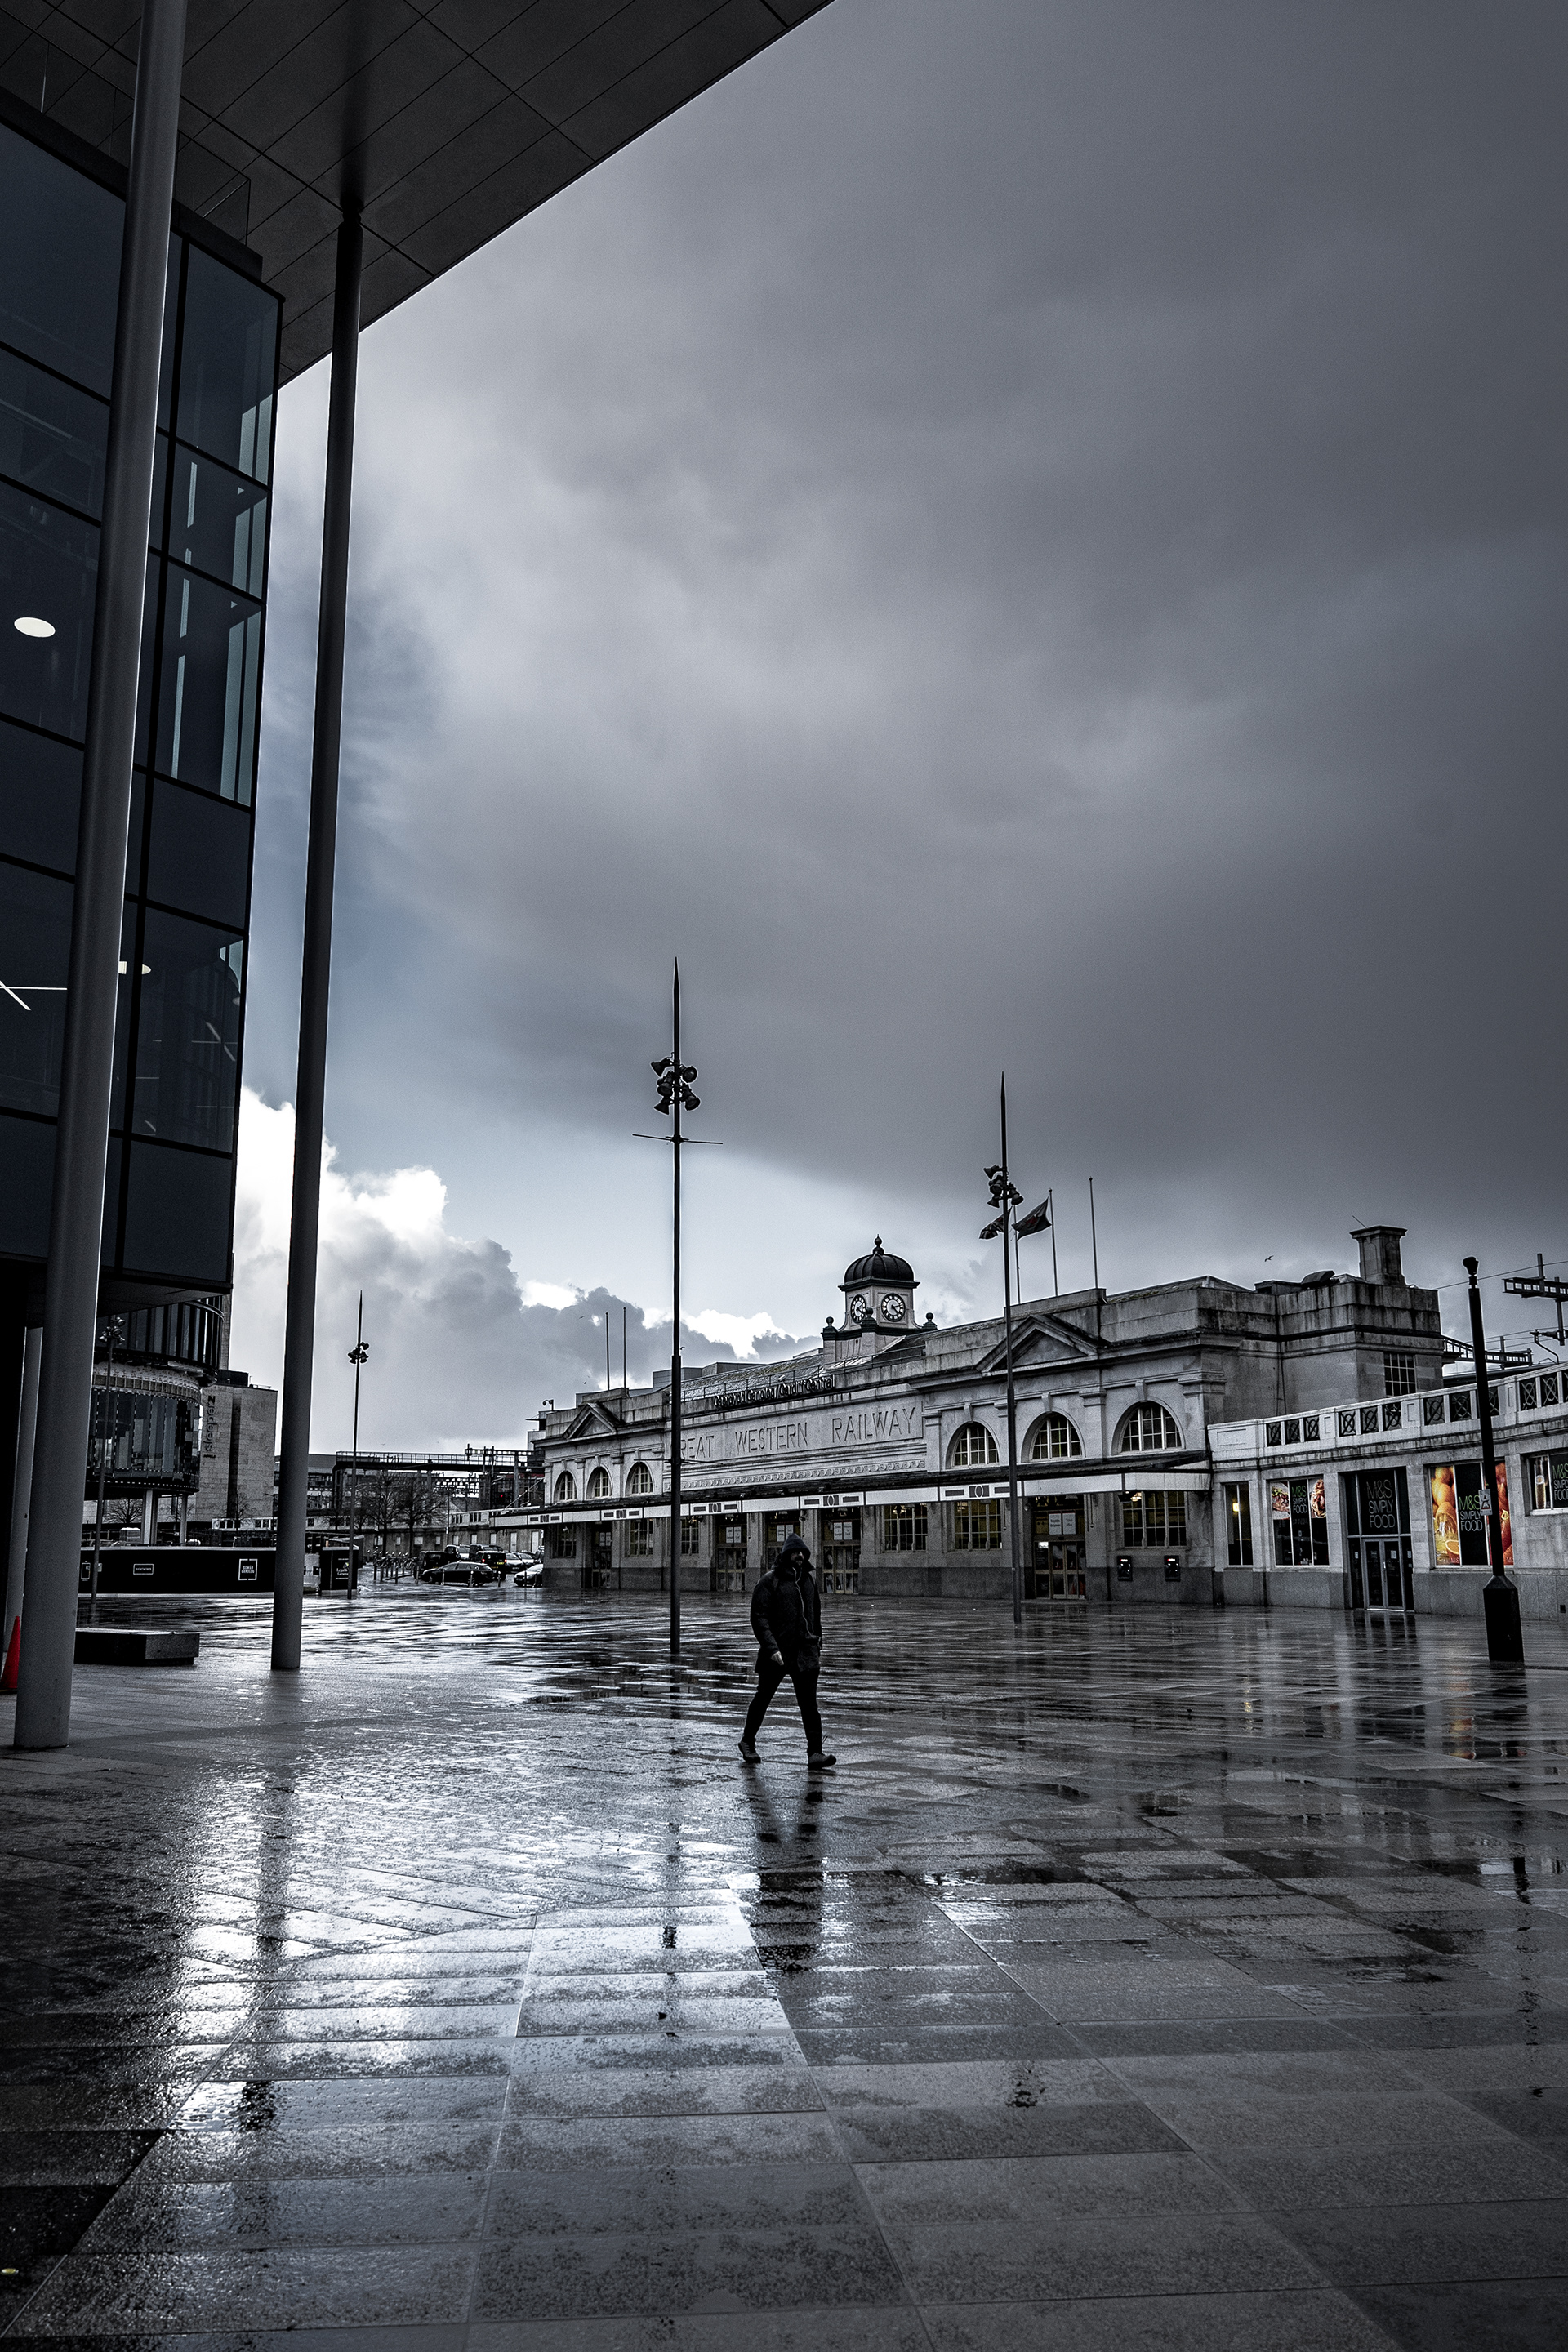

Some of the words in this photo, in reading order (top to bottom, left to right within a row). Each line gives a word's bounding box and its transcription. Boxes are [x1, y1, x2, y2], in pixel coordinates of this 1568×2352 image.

[805, 1374, 836, 1392] Central
[673, 1435, 715, 1460] REAT
[735, 1422, 808, 1454] WESTERN
[831, 1406, 916, 1443] RAILWAY
[1291, 1485, 1307, 1498] M&S
[1365, 1479, 1392, 1499] M&S
[1554, 1488, 1568, 1501] FOO
[1293, 1504, 1307, 1514] FOOD
[1368, 1499, 1394, 1514] SIMPLY
[1459, 1494, 1481, 1510] M&S
[1369, 1514, 1396, 1529] FOOD
[1460, 1510, 1481, 1521] SIMPLY
[1460, 1520, 1483, 1532] FOOD
